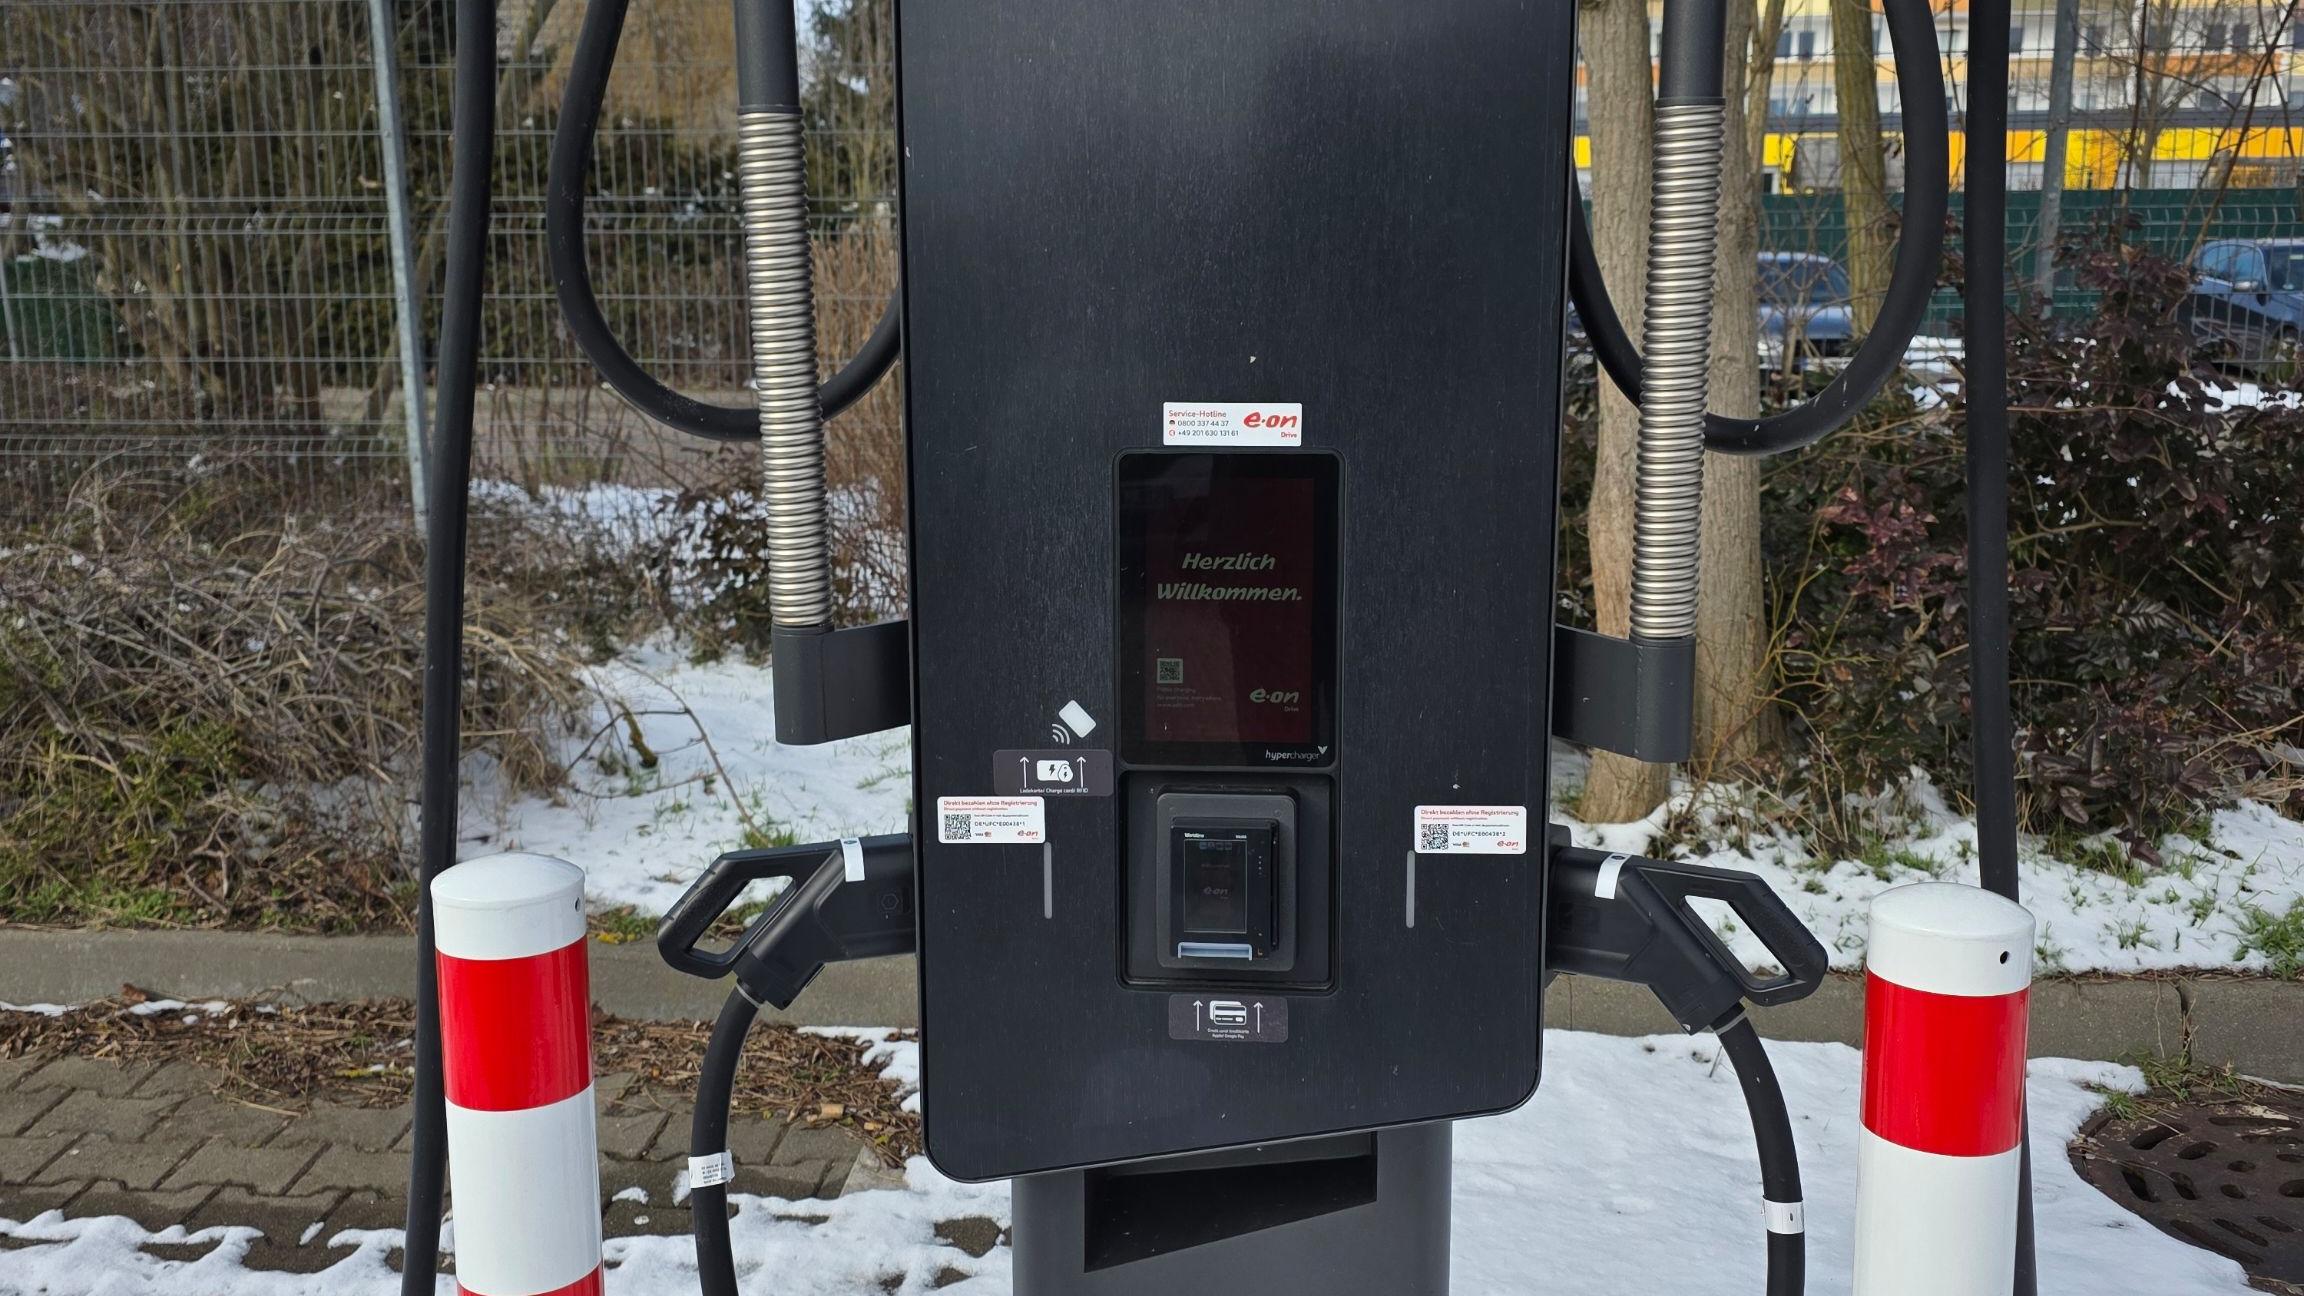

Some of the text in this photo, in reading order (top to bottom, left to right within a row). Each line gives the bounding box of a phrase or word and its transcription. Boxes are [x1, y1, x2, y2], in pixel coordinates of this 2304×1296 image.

[1168, 410, 1227, 418] Service-Hotline
[1181, 552, 1276, 570] Herzlich
[1156, 581, 1303, 600] Willkommen.
[1265, 749, 1320, 762] hypercharger
